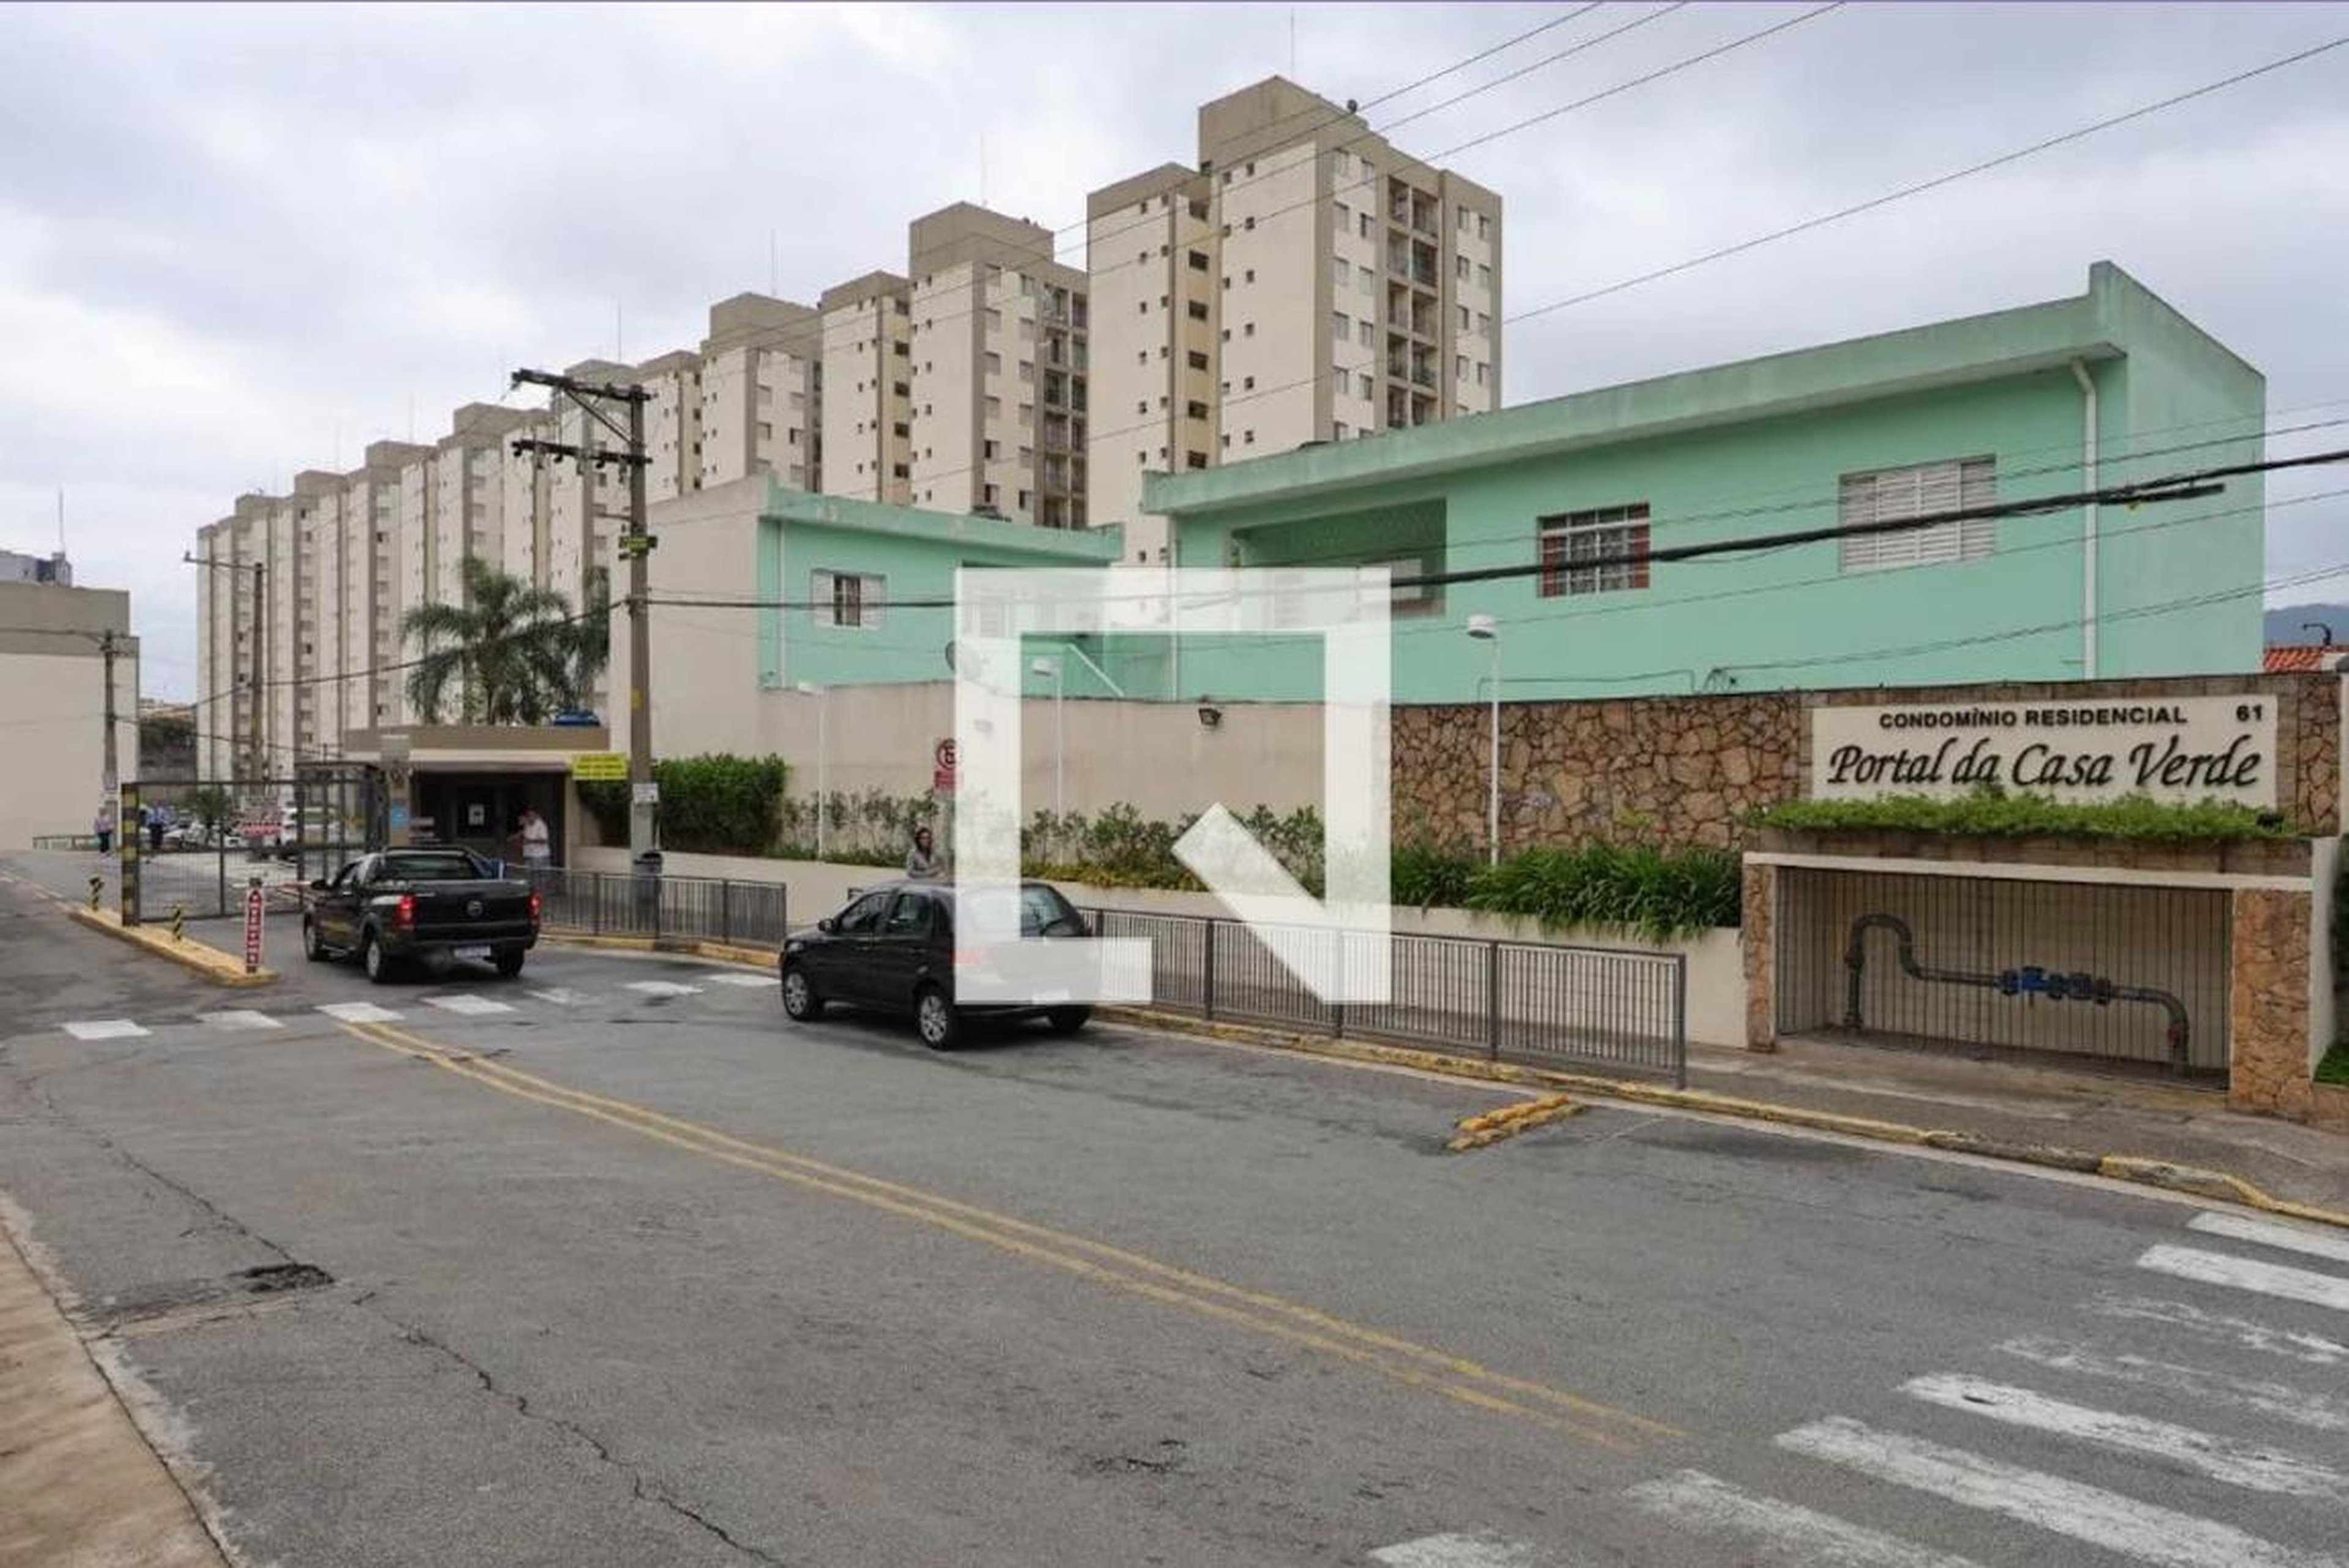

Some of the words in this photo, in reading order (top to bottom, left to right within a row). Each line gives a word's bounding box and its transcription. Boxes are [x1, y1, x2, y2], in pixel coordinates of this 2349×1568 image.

[1879, 707, 2017, 729] CONDOMÍNIO
[2025, 706, 2188, 727] RESIDENCIAL
[2236, 704, 2264, 722] 61
[1827, 736, 1959, 785] Portal
[1951, 736, 2002, 785] da
[2011, 742, 2114, 787] Casa
[2129, 734, 2262, 788] Verde
